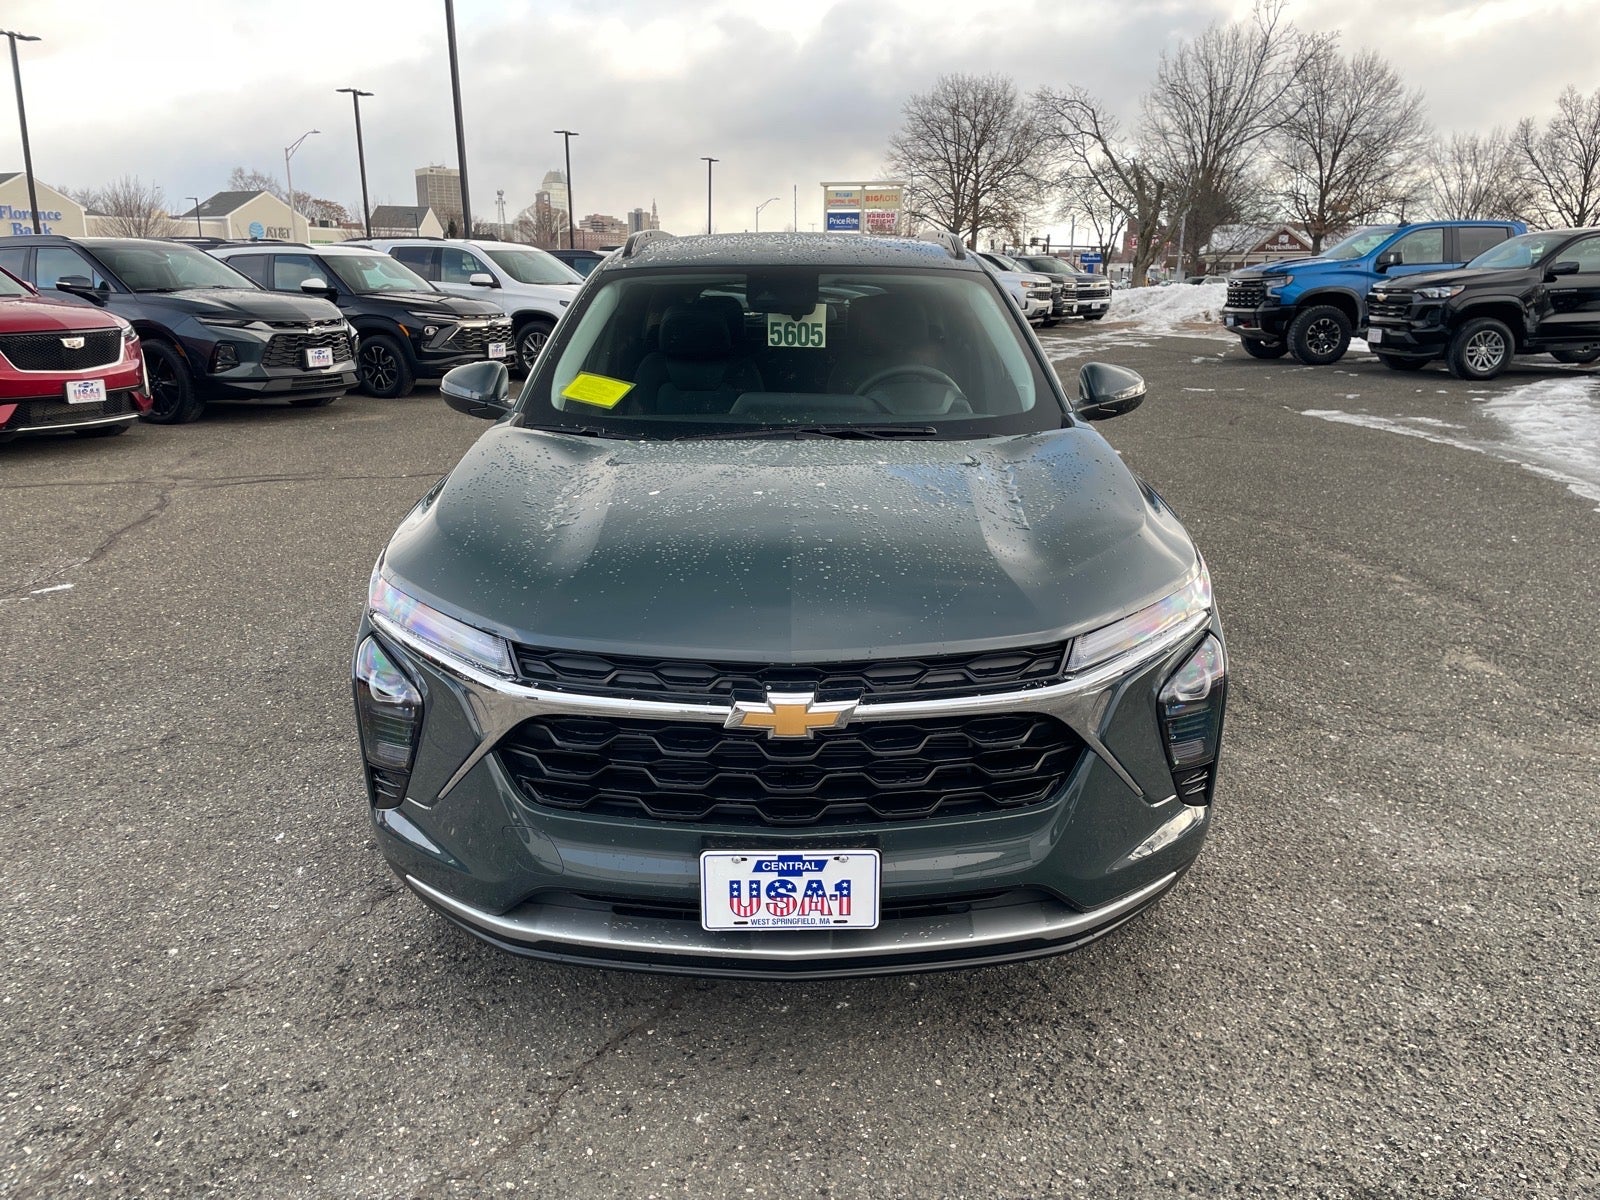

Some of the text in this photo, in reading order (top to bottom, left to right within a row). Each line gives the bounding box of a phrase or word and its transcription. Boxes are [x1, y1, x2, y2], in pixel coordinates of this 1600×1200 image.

[829, 217, 859, 225] Price Rite
[11, 222, 52, 236] Bak
[265, 226, 291, 239] AT&T
[769, 321, 824, 347] 5605
[762, 861, 819, 871] CENTRAL
[729, 879, 852, 917] USA-1
[750, 918, 770, 926] WEST
[771, 918, 817, 926] SPRINGFIELD,
